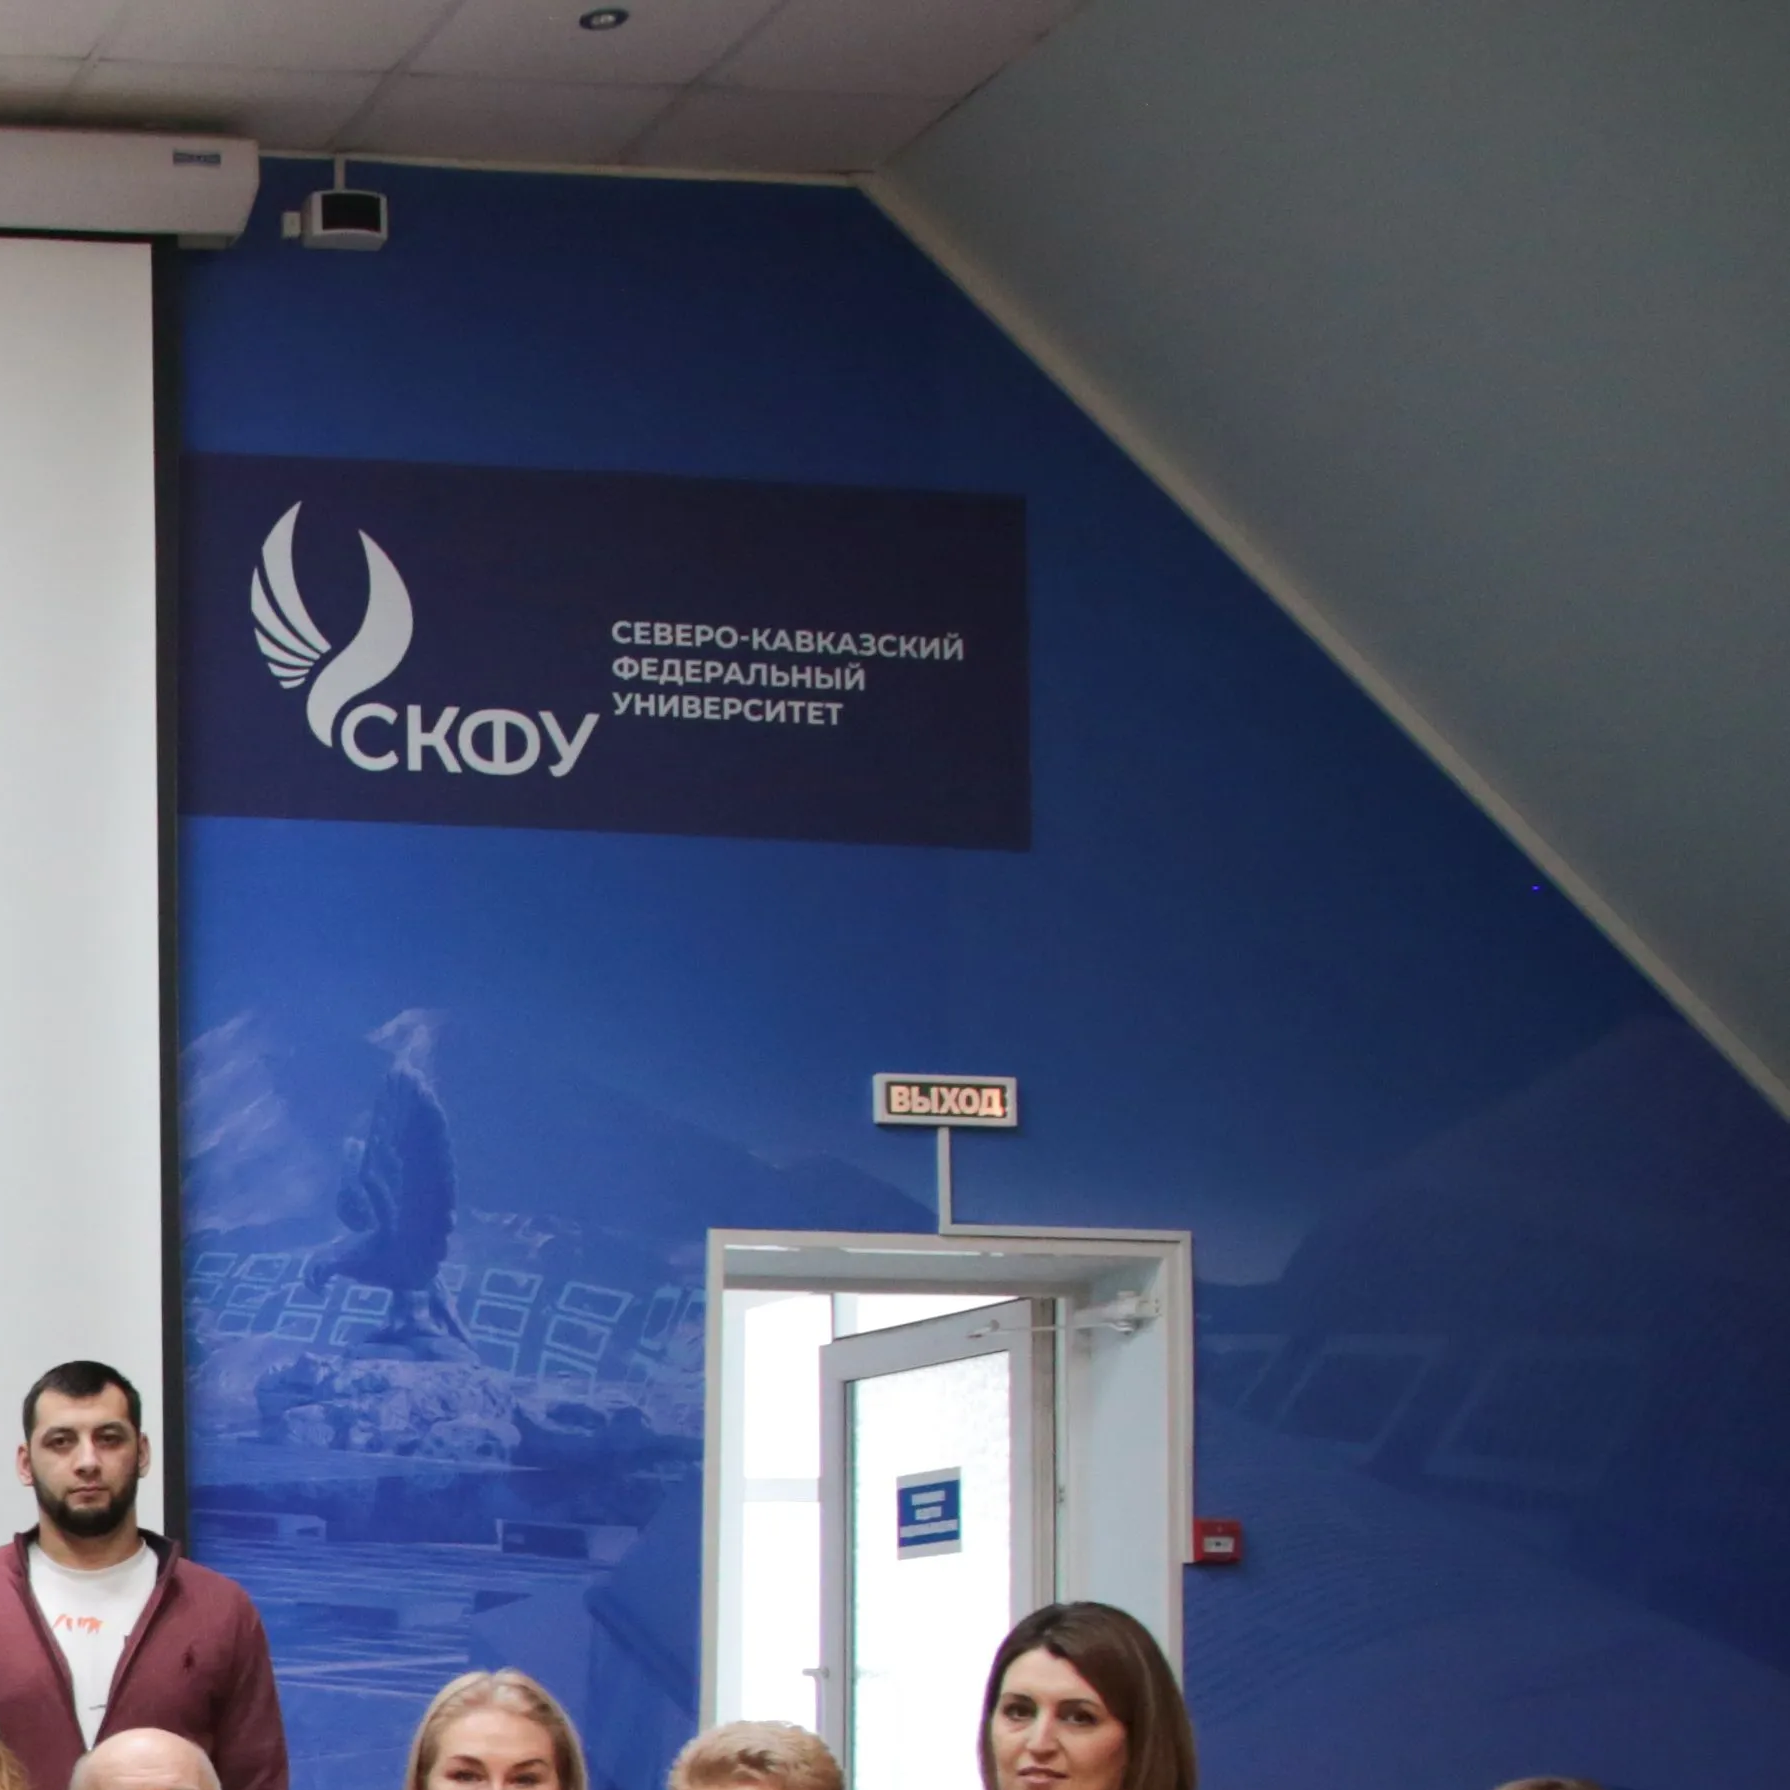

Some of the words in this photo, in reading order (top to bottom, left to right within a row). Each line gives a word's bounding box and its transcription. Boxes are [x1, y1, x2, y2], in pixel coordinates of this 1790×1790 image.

[611, 620, 965, 661] СЕВЕРО-КАВКАЗСКИЙ
[611, 655, 867, 691] ФЕДЕРАЛЬНЫЙ
[612, 691, 844, 726] УНИВЕРСИТЕТ
[340, 702, 600, 778] СКФУ
[889, 1084, 1005, 1117] ВЫХОД
